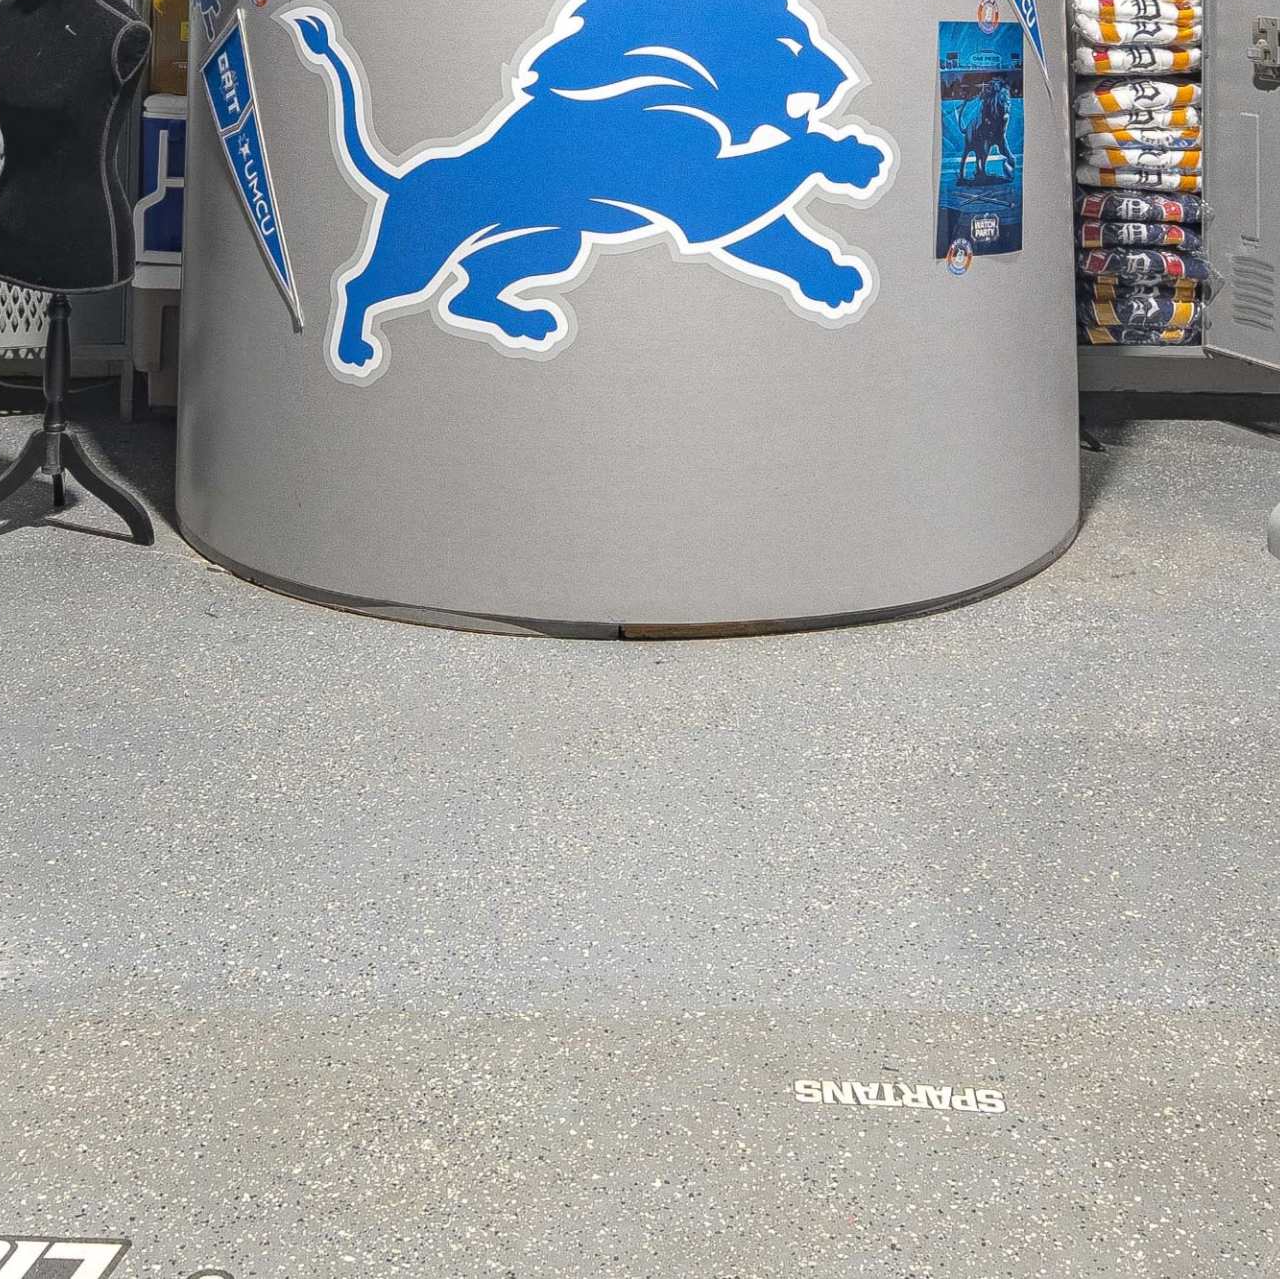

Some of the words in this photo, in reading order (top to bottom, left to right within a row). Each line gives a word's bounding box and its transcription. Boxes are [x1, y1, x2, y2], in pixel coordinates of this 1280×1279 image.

[216, 52, 242, 115] GRIT
[243, 159, 276, 237] UMCU
[974, 218, 996, 229] WATCH
[974, 228, 995, 238] PARTY
[793, 1078, 1008, 1115] SPARTANS
